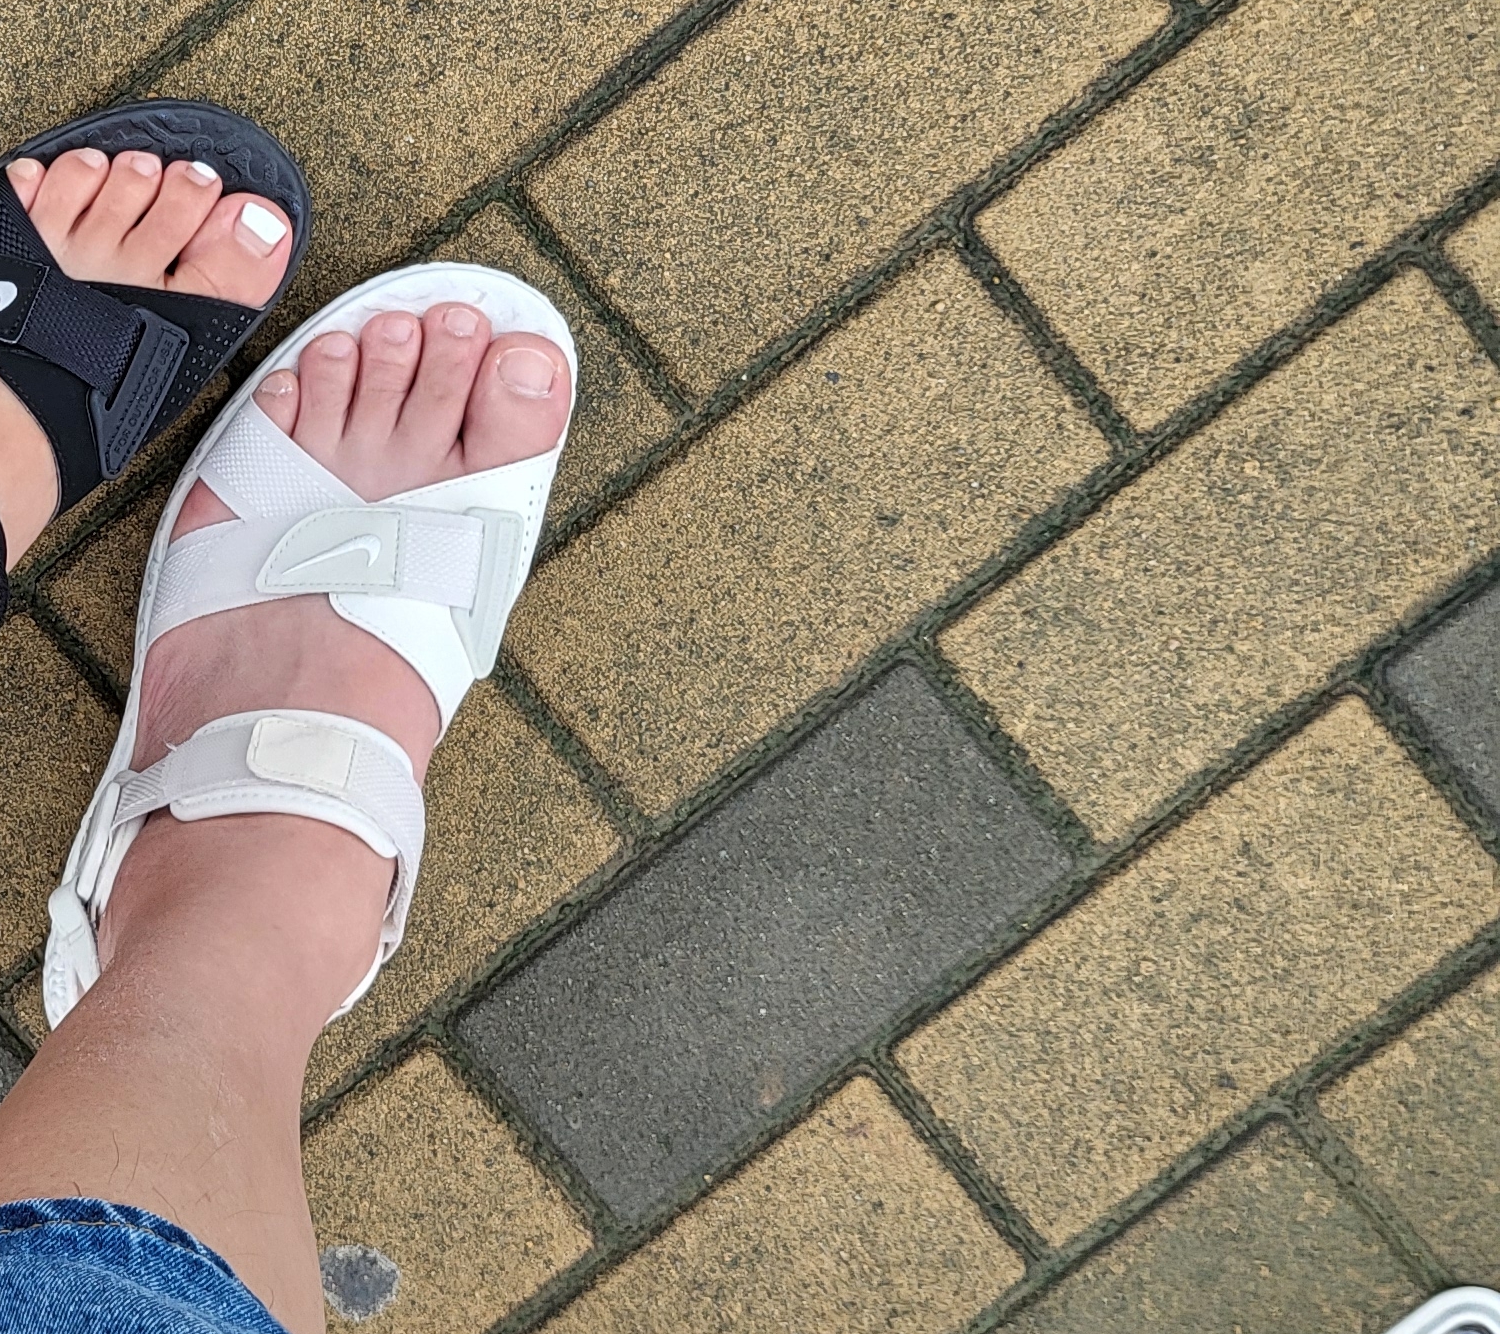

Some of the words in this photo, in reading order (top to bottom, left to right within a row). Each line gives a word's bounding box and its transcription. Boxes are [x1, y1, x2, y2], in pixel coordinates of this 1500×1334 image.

[114, 430, 131, 454] FOR
[128, 367, 161, 427] OUTDOOR
[160, 339, 174, 366] USE
